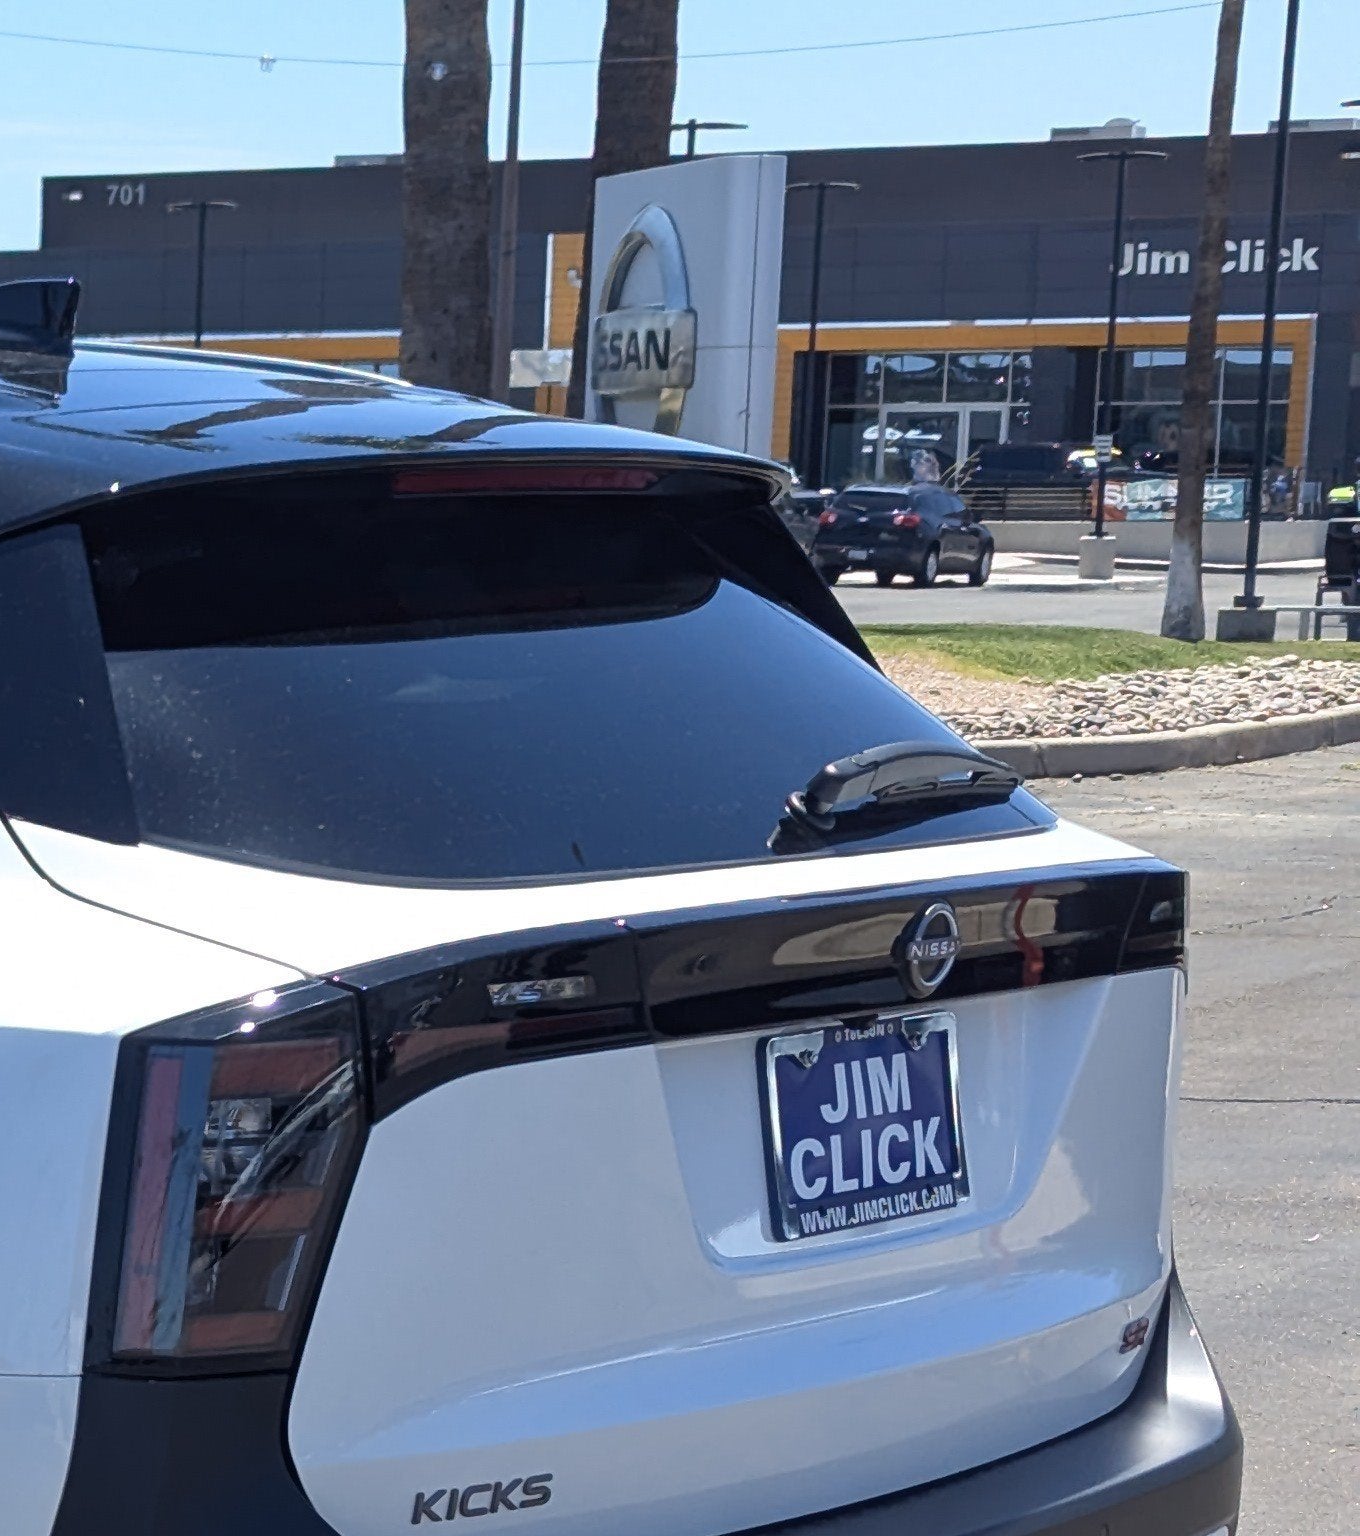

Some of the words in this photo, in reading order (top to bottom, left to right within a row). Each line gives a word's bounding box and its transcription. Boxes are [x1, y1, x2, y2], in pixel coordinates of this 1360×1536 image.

[107, 183, 145, 206] 701
[1109, 241, 1190, 276] Jim
[820, 1052, 912, 1124] JIM
[790, 1116, 946, 1200] CLICK
[800, 1184, 954, 1234] WWW.JIMCLICK.COM
[411, 1473, 553, 1525] KICKS
